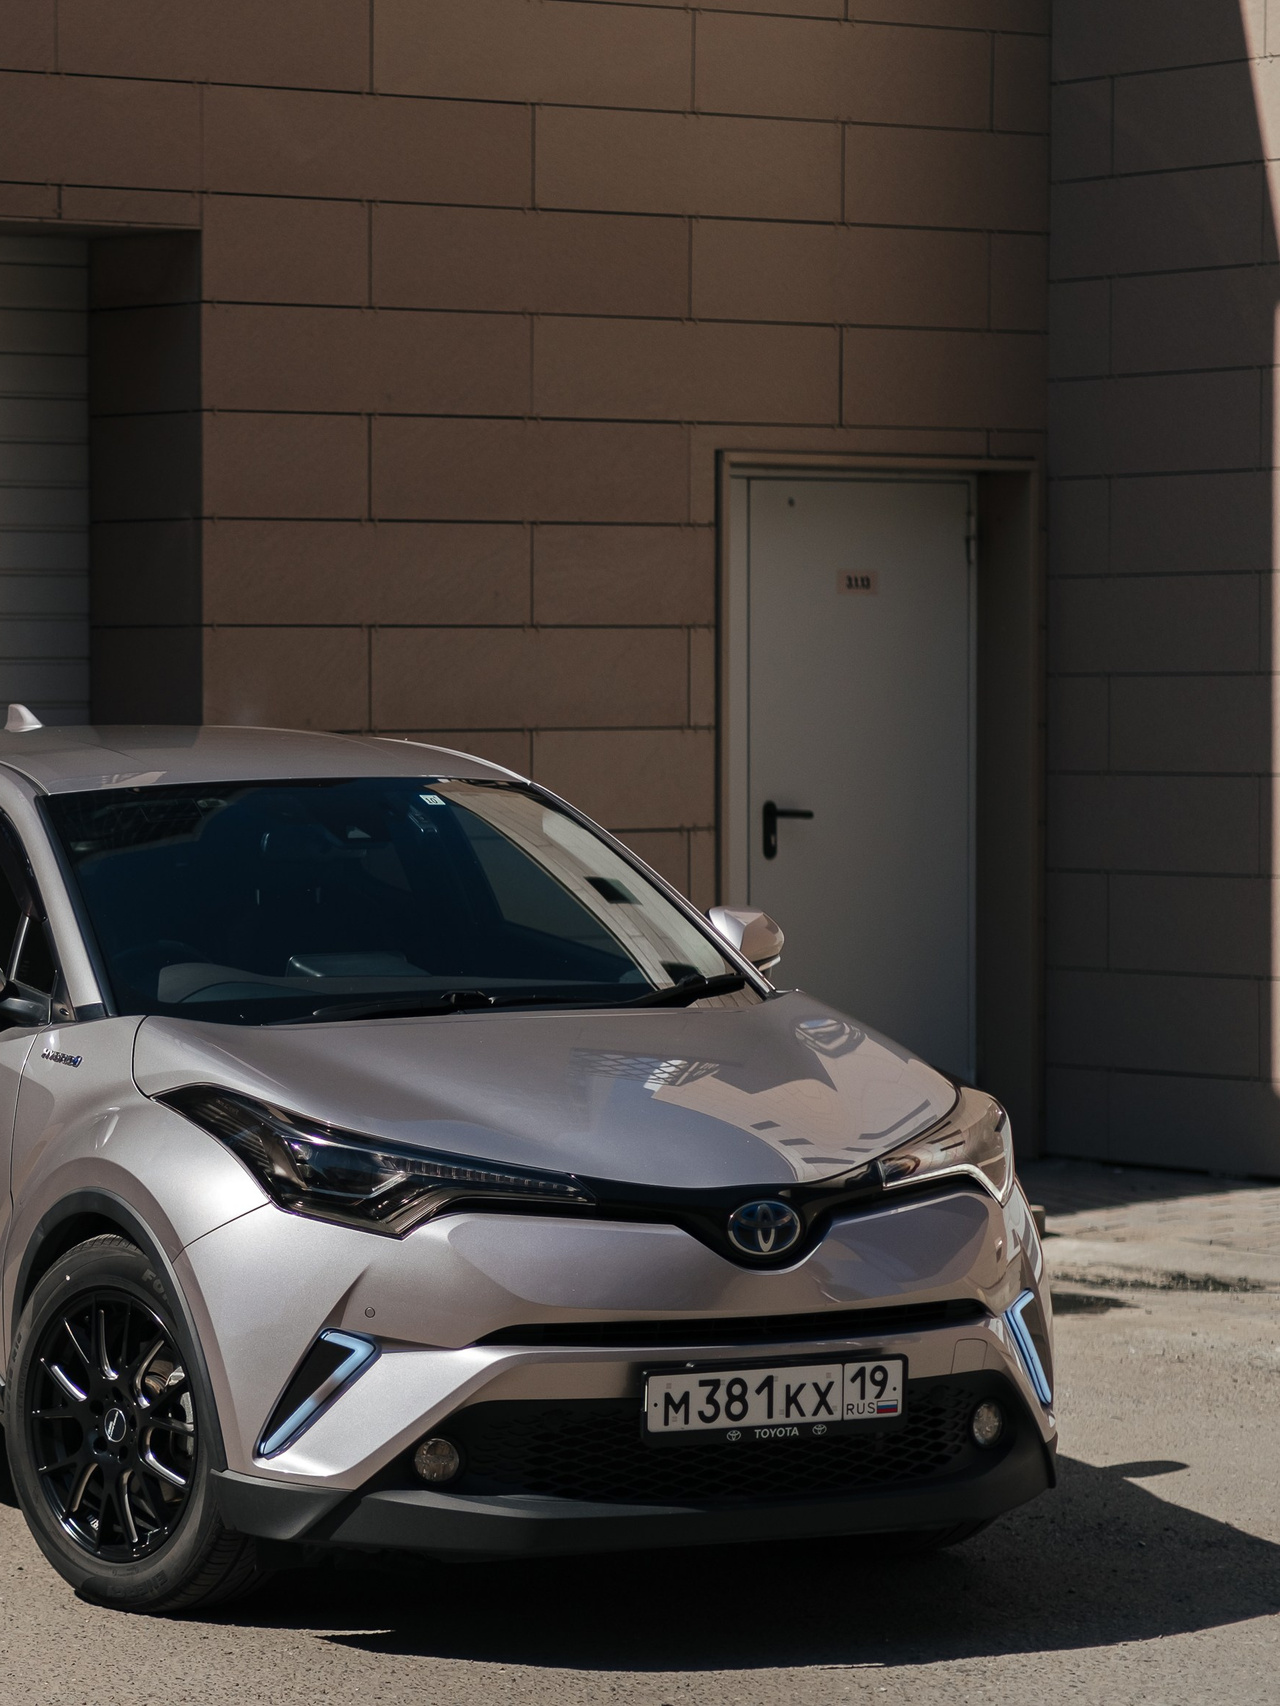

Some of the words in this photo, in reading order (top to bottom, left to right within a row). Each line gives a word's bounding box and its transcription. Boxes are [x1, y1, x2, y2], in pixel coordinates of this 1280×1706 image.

[850, 1364, 889, 1401] 19
[846, 1402, 876, 1416] RUS
[754, 1426, 800, 1440] TOYOTA
